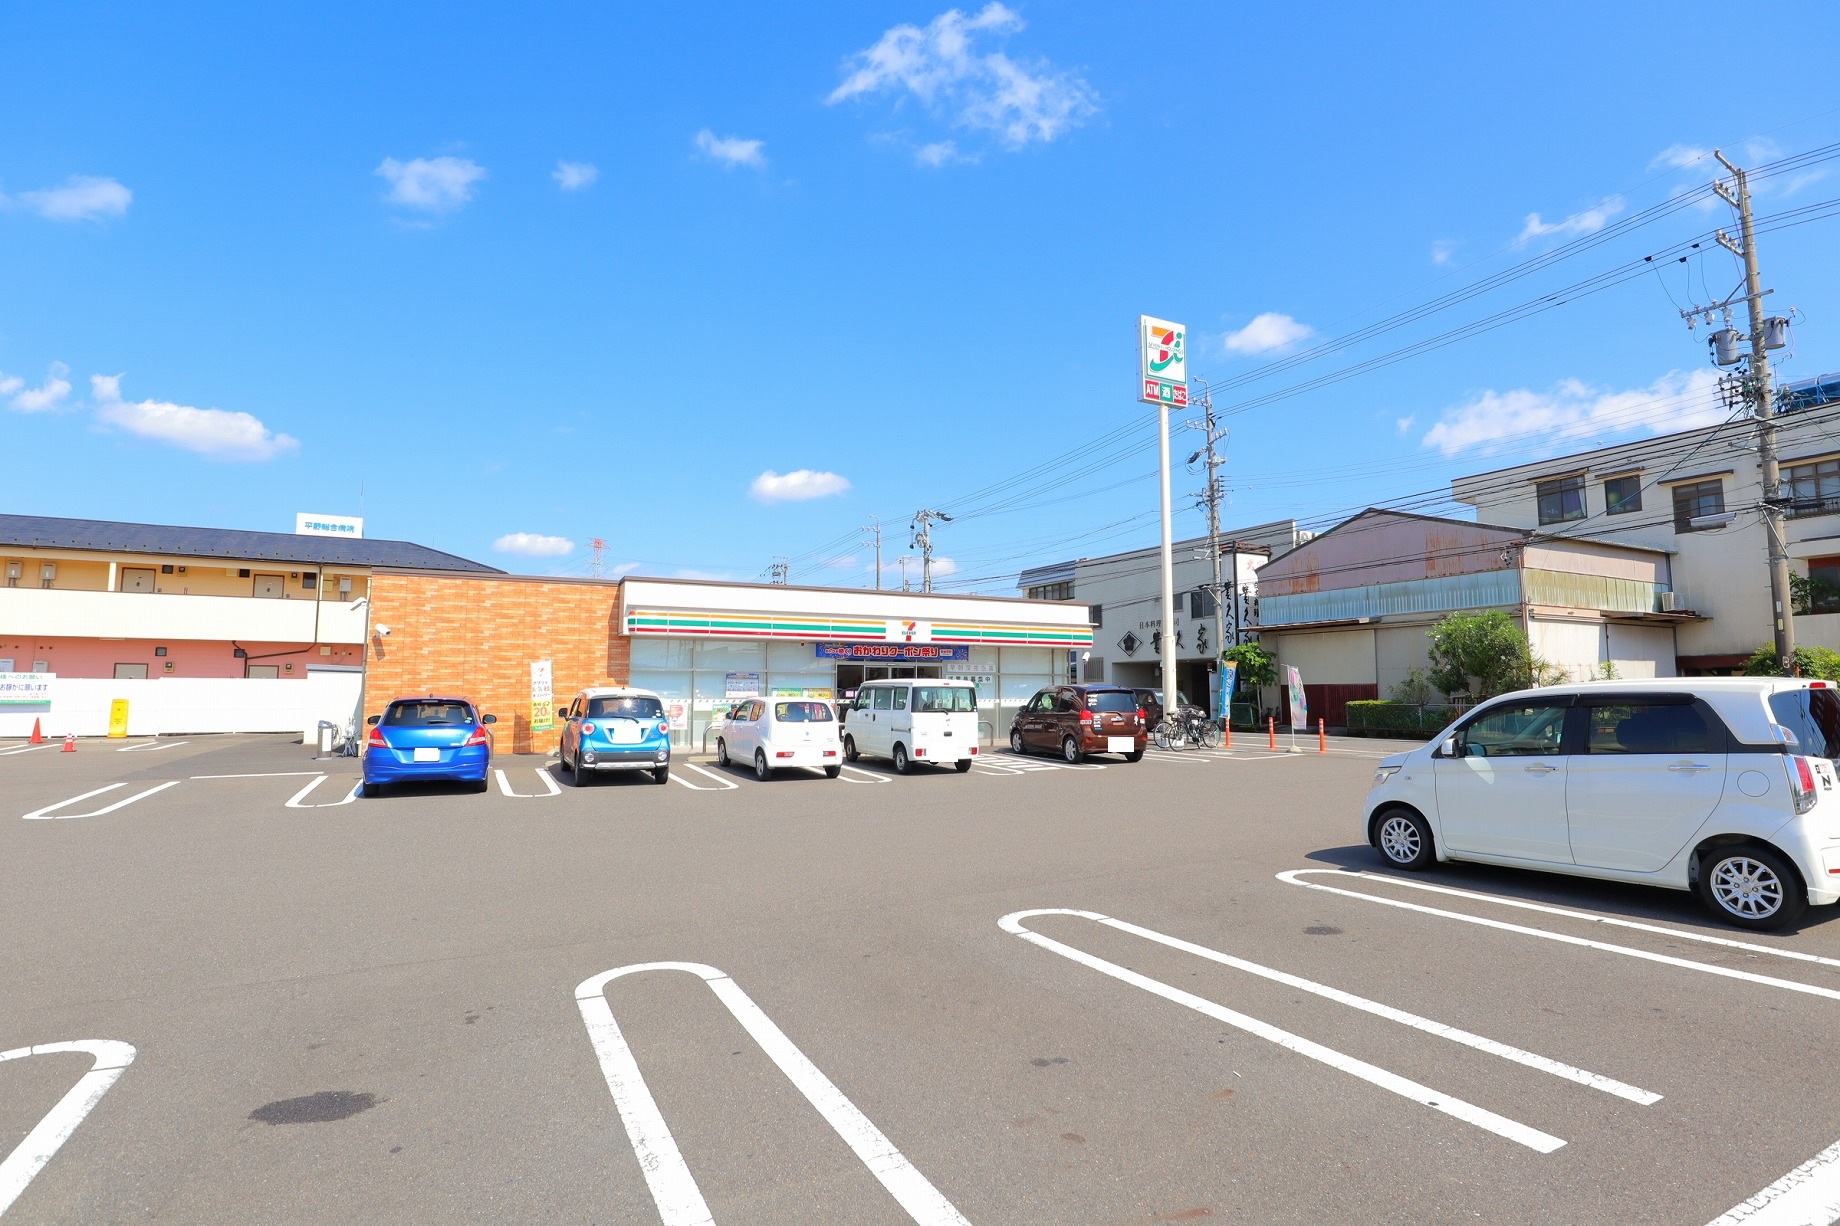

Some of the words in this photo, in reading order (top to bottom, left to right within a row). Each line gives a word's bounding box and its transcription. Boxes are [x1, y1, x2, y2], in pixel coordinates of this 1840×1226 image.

[1146, 384, 1159, 396] ATM
[1162, 386, 1171, 398] 酒
[304, 521, 355, 533] 平野総合病院
[853, 645, 939, 658] おかわりクーポン祭り
